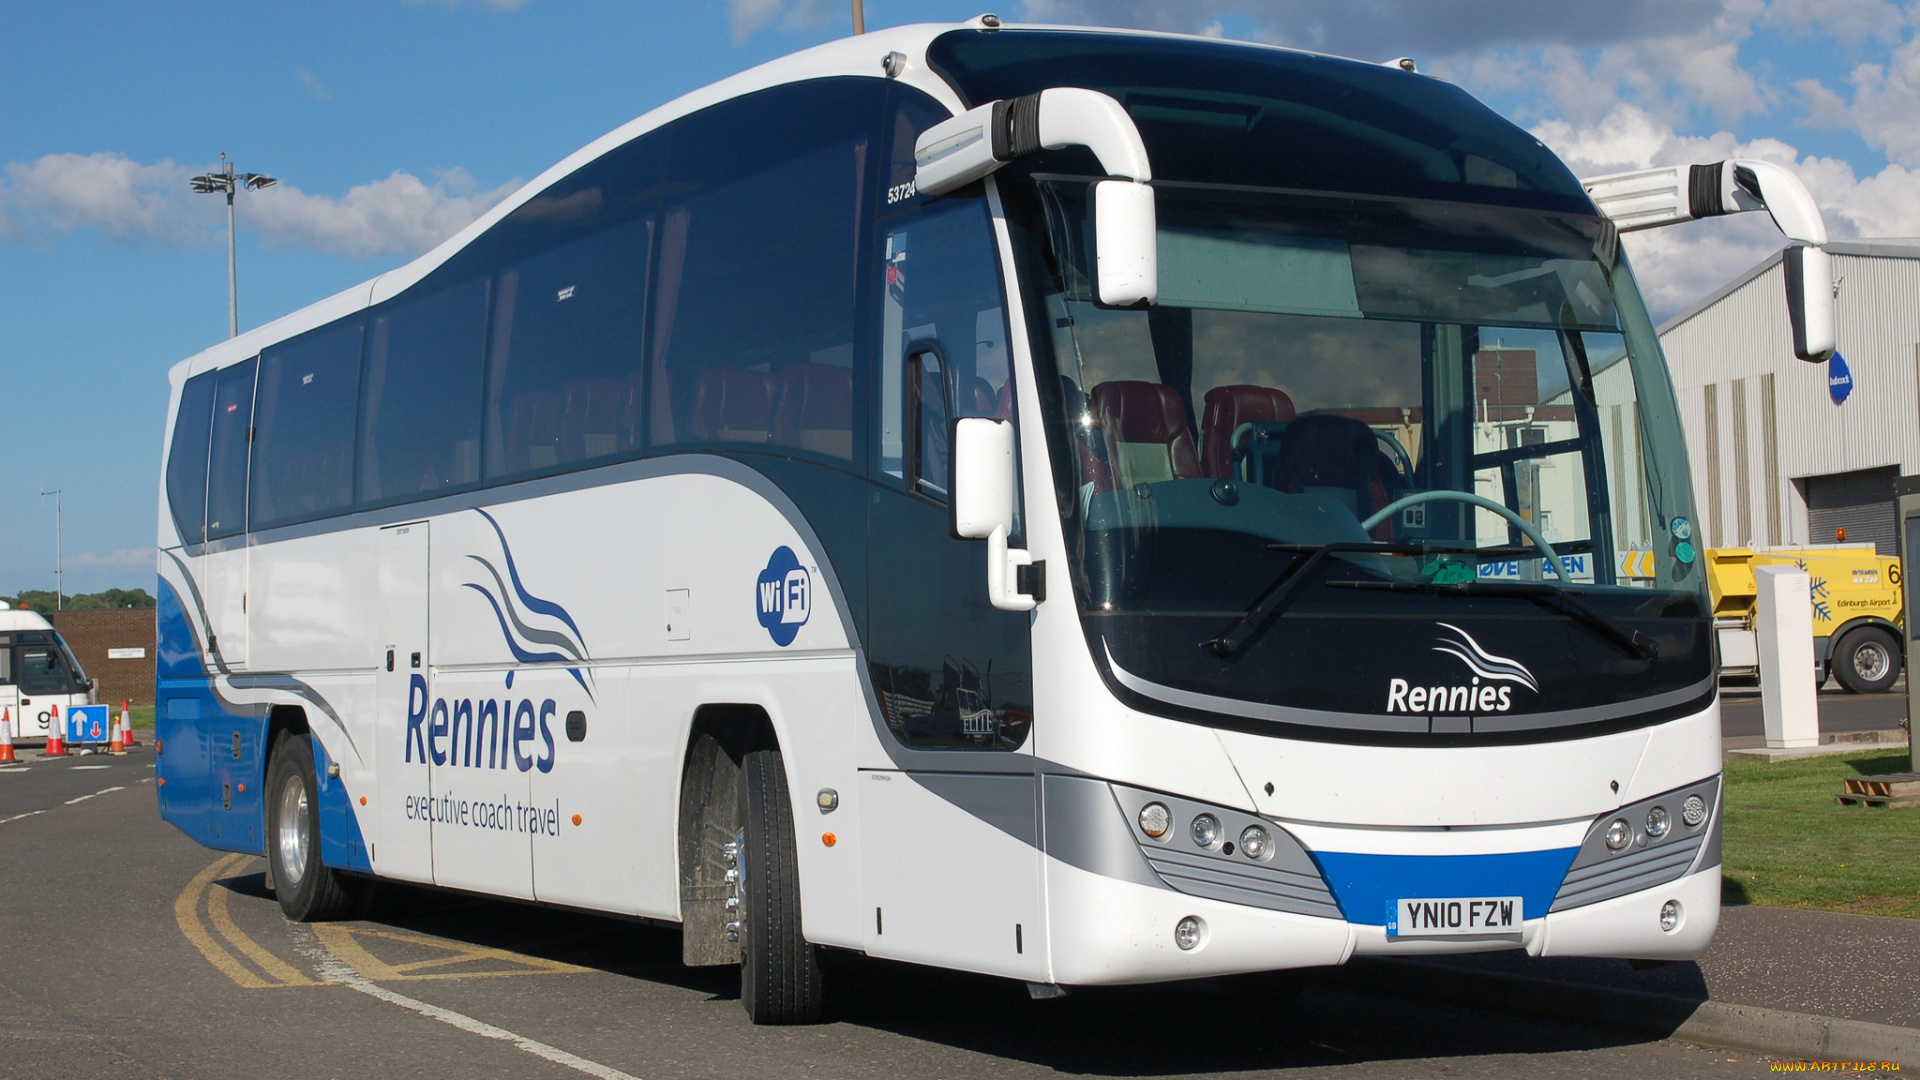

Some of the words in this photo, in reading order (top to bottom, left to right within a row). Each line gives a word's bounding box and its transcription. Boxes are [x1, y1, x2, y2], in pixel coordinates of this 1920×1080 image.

[888, 181, 915, 204] 53724
[1888, 564, 1900, 584] 6
[1837, 599, 1868, 607] Edinburgh
[1869, 599, 1891, 607] Airport
[1386, 676, 1512, 713] Rennies
[37, 711, 50, 729] 9
[405, 670, 556, 774] Rennies
[963, 711, 993, 732] ELITE
[406, 790, 469, 826] executive
[472, 793, 513, 831] coach
[516, 797, 560, 836] travel
[1407, 902, 1462, 928] YN10
[1469, 900, 1513, 927] FZW
